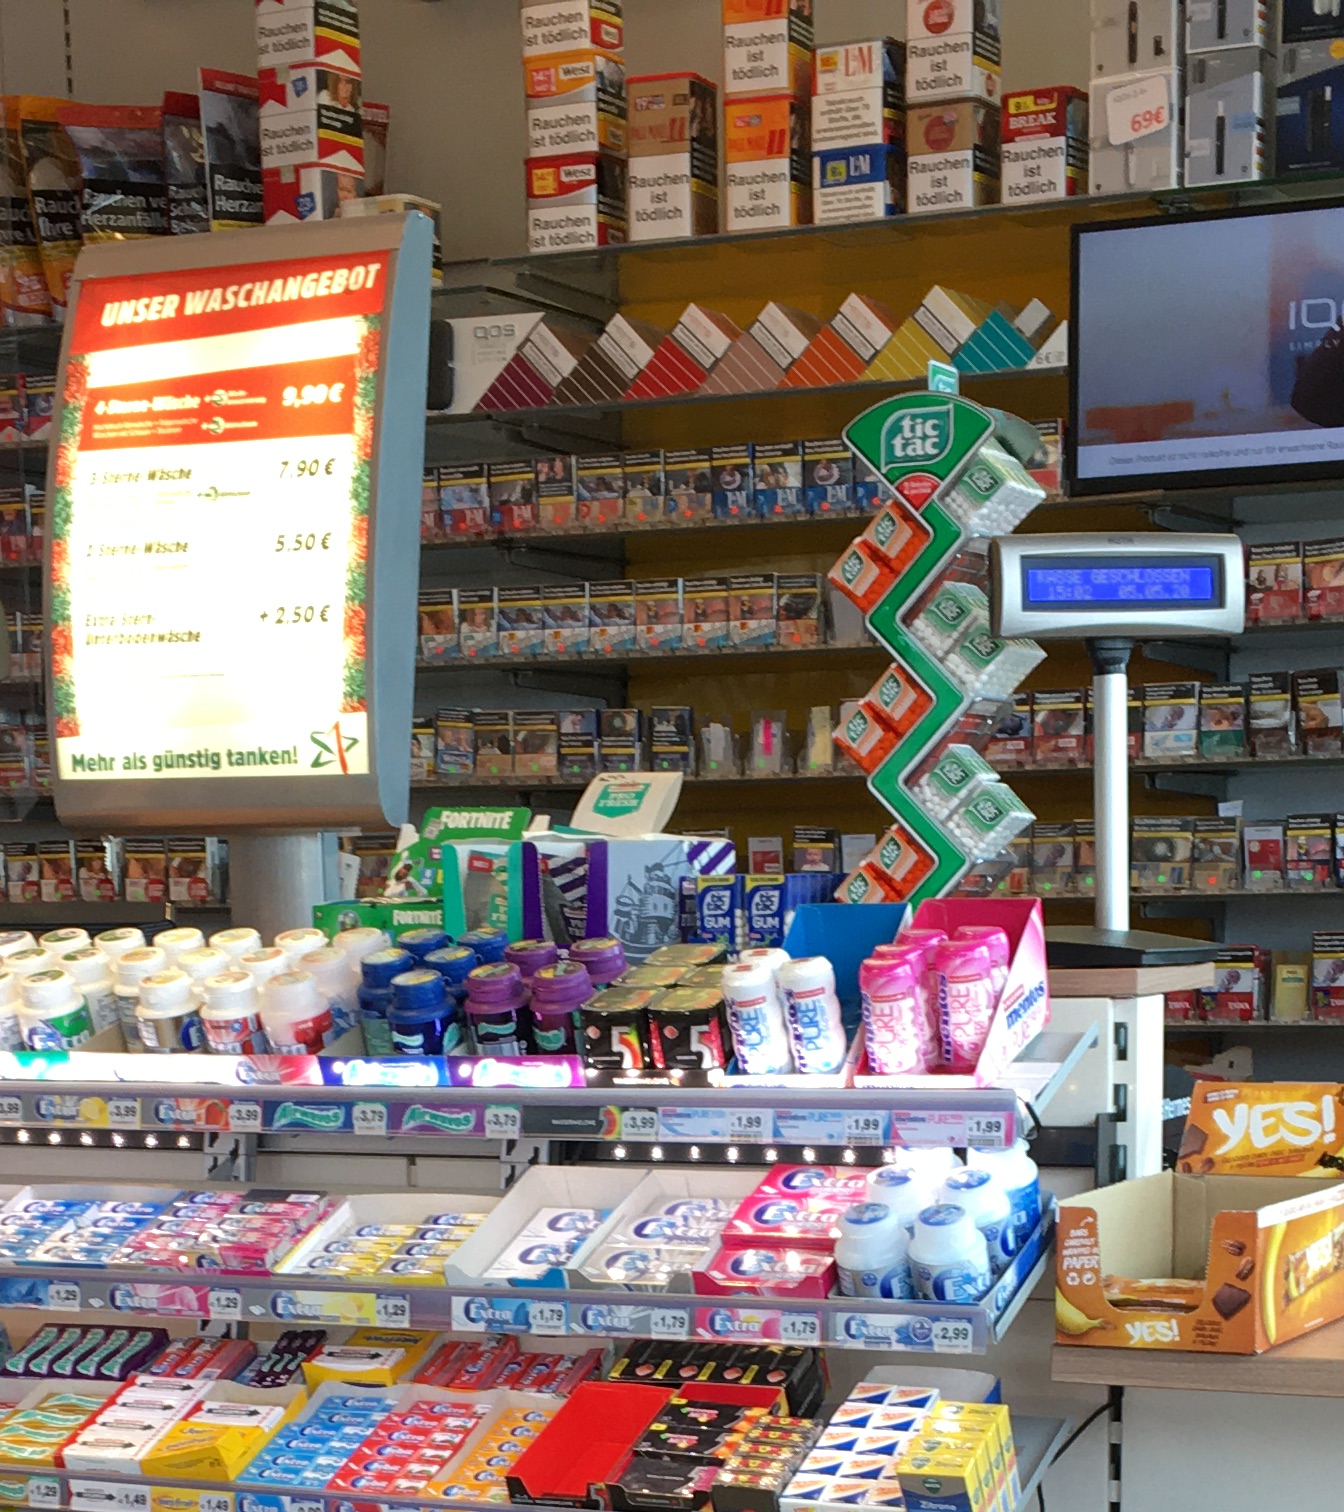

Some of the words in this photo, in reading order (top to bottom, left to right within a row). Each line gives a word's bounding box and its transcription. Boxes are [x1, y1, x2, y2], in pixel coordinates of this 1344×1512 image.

[525, 10, 584, 30] Rauchen
[540, 26, 588, 44] tödlich
[726, 33, 786, 49] Rauchen
[908, 41, 969, 59] Rauchen
[561, 64, 591, 79] West
[732, 64, 779, 80] tödlich
[915, 74, 963, 91] tödlich
[532, 112, 592, 130] Rauchen
[1009, 112, 1057, 129] BREAK
[1130, 106, 1165, 133] 69€
[548, 130, 596, 148] tödlich
[1003, 146, 1065, 164] Rauchen
[563, 165, 595, 179] West
[729, 173, 787, 188] Rauchen
[1008, 179, 1057, 196] tödlich
[733, 203, 780, 220] tödlich
[532, 215, 592, 232] Rauchen
[548, 230, 596, 248] tödlich
[100, 294, 181, 328] UNSER
[182, 263, 382, 317] WASCHANGEBOT
[902, 415, 940, 438] tic
[892, 436, 940, 458] tac
[1036, 570, 1083, 584] KASSE
[1090, 568, 1191, 584] GESCHLOSSEN
[71, 752, 116, 773] Mehr
[121, 750, 148, 771] als
[153, 748, 222, 772] günstig
[227, 746, 299, 768] tanken!
[440, 809, 515, 832] FORTNITE
[392, 908, 443, 926] FORTNITE
[704, 915, 731, 929] GUM
[752, 915, 780, 929] GUM
[1212, 1094, 1337, 1156] YES!
[1125, 1318, 1180, 1346] YES!
